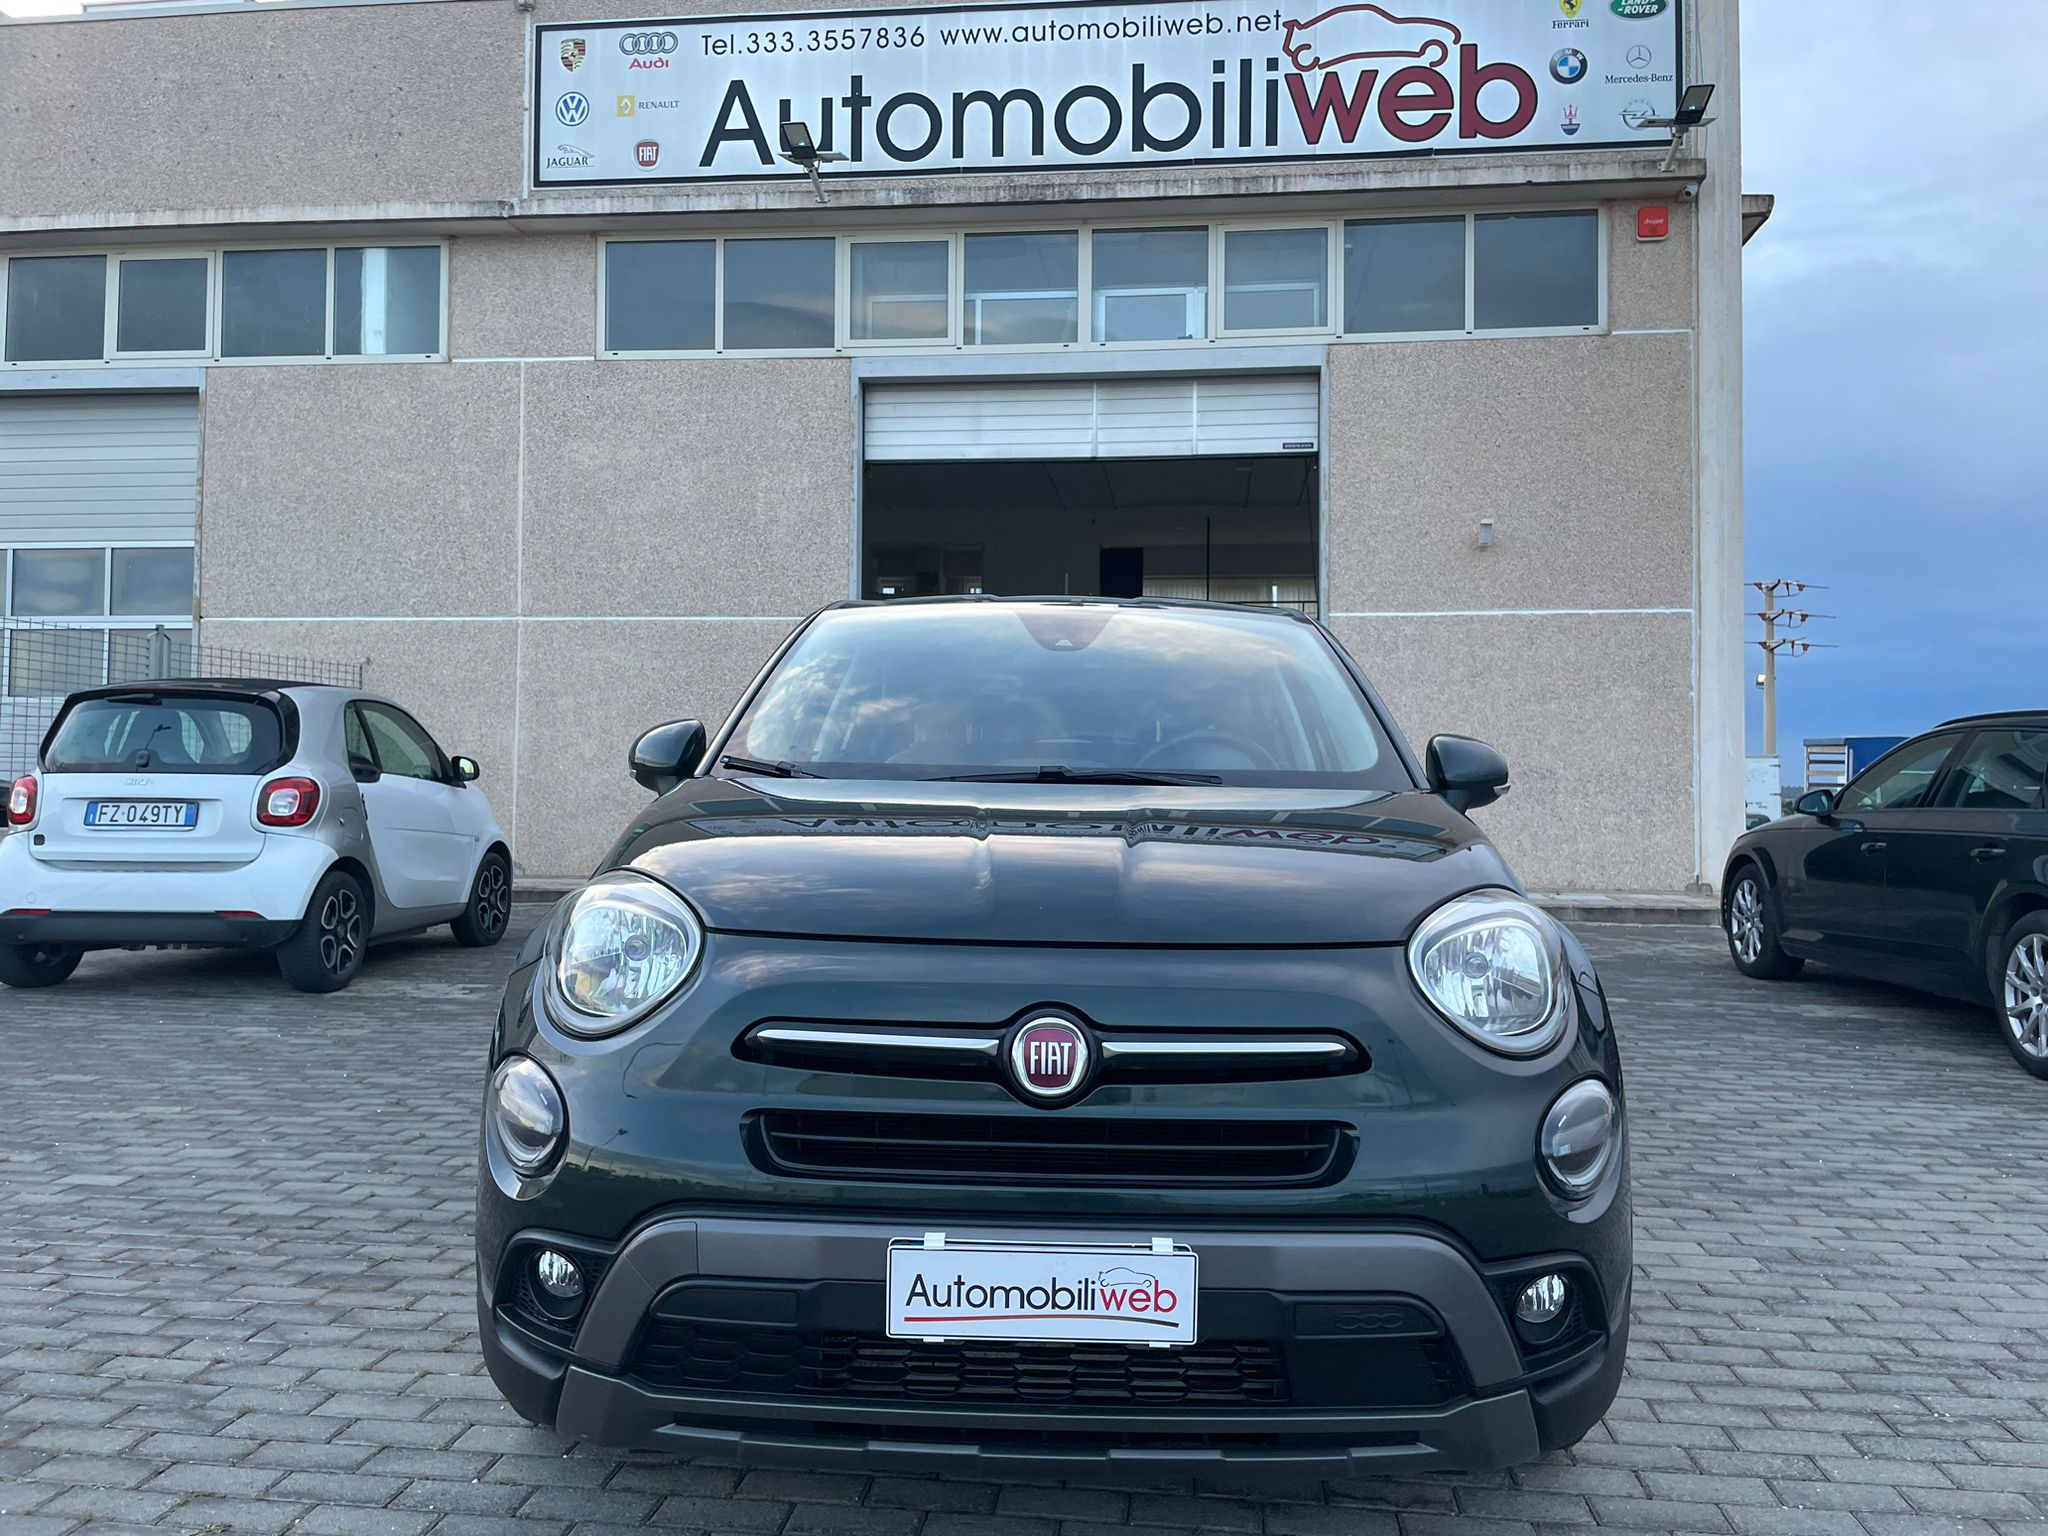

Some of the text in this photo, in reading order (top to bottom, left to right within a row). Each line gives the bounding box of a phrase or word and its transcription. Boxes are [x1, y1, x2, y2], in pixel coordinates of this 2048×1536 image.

[1623, 5, 1658, 14] ROVER
[1552, 20, 1589, 29] Ferrari
[701, 10, 1281, 55] Tel.333.3557836 www.automobiliweb.net
[629, 57, 669, 69] Audi
[1605, 74, 1673, 84] Mercedes-Benz
[639, 101, 680, 109] RENAULT
[699, 44, 1538, 168] Automobiliweb
[639, 147, 658, 161] FIAT
[546, 157, 588, 169] JAGUAR
[98, 805, 119, 822] FZ
[127, 805, 183, 823] 049TY
[1030, 1041, 1072, 1075] FIAT
[905, 1273, 1178, 1313] Automobiliweb
